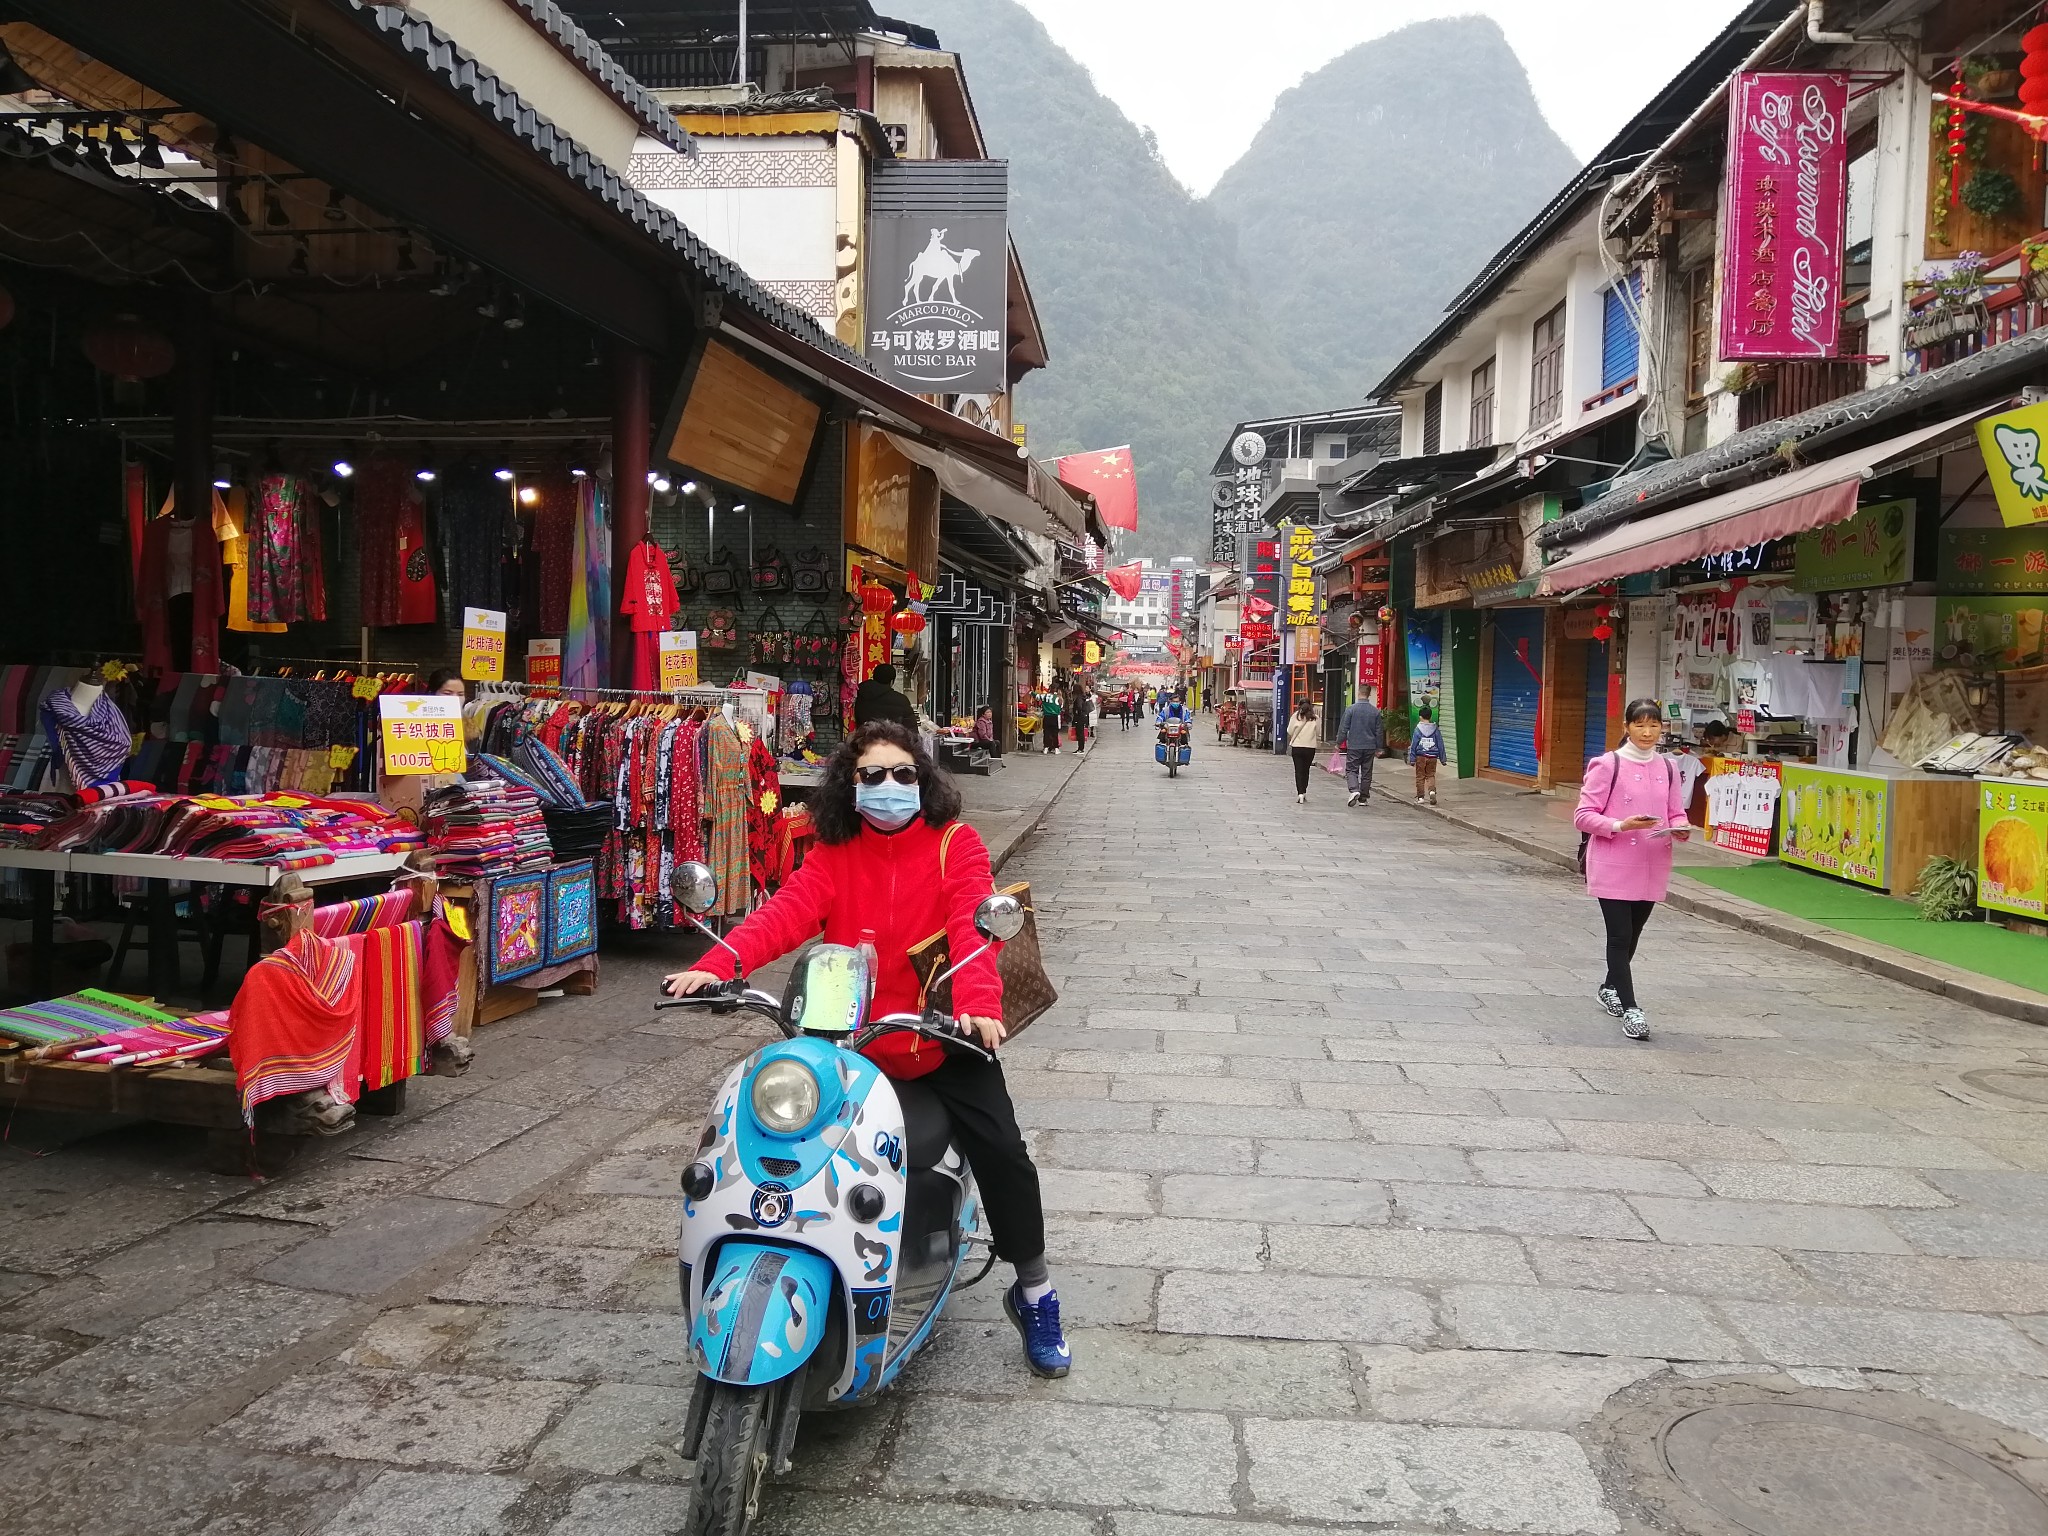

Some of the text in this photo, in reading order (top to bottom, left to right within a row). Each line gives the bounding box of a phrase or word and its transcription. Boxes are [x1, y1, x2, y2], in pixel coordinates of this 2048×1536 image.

[1791, 246, 1829, 358] Hotel
[898, 305, 972, 323] MARCO POLO
[871, 329, 1001, 351] 马可波罗酒吧
[894, 355, 976, 366] MUSIC BAR
[1234, 466, 1262, 520] 地球村
[1213, 507, 1235, 551] 地球村
[1235, 520, 1260, 533] 酒吧
[465, 635, 503, 653] 此排清仓
[392, 722, 455, 739] 手织披肩
[390, 752, 431, 767] 100元
